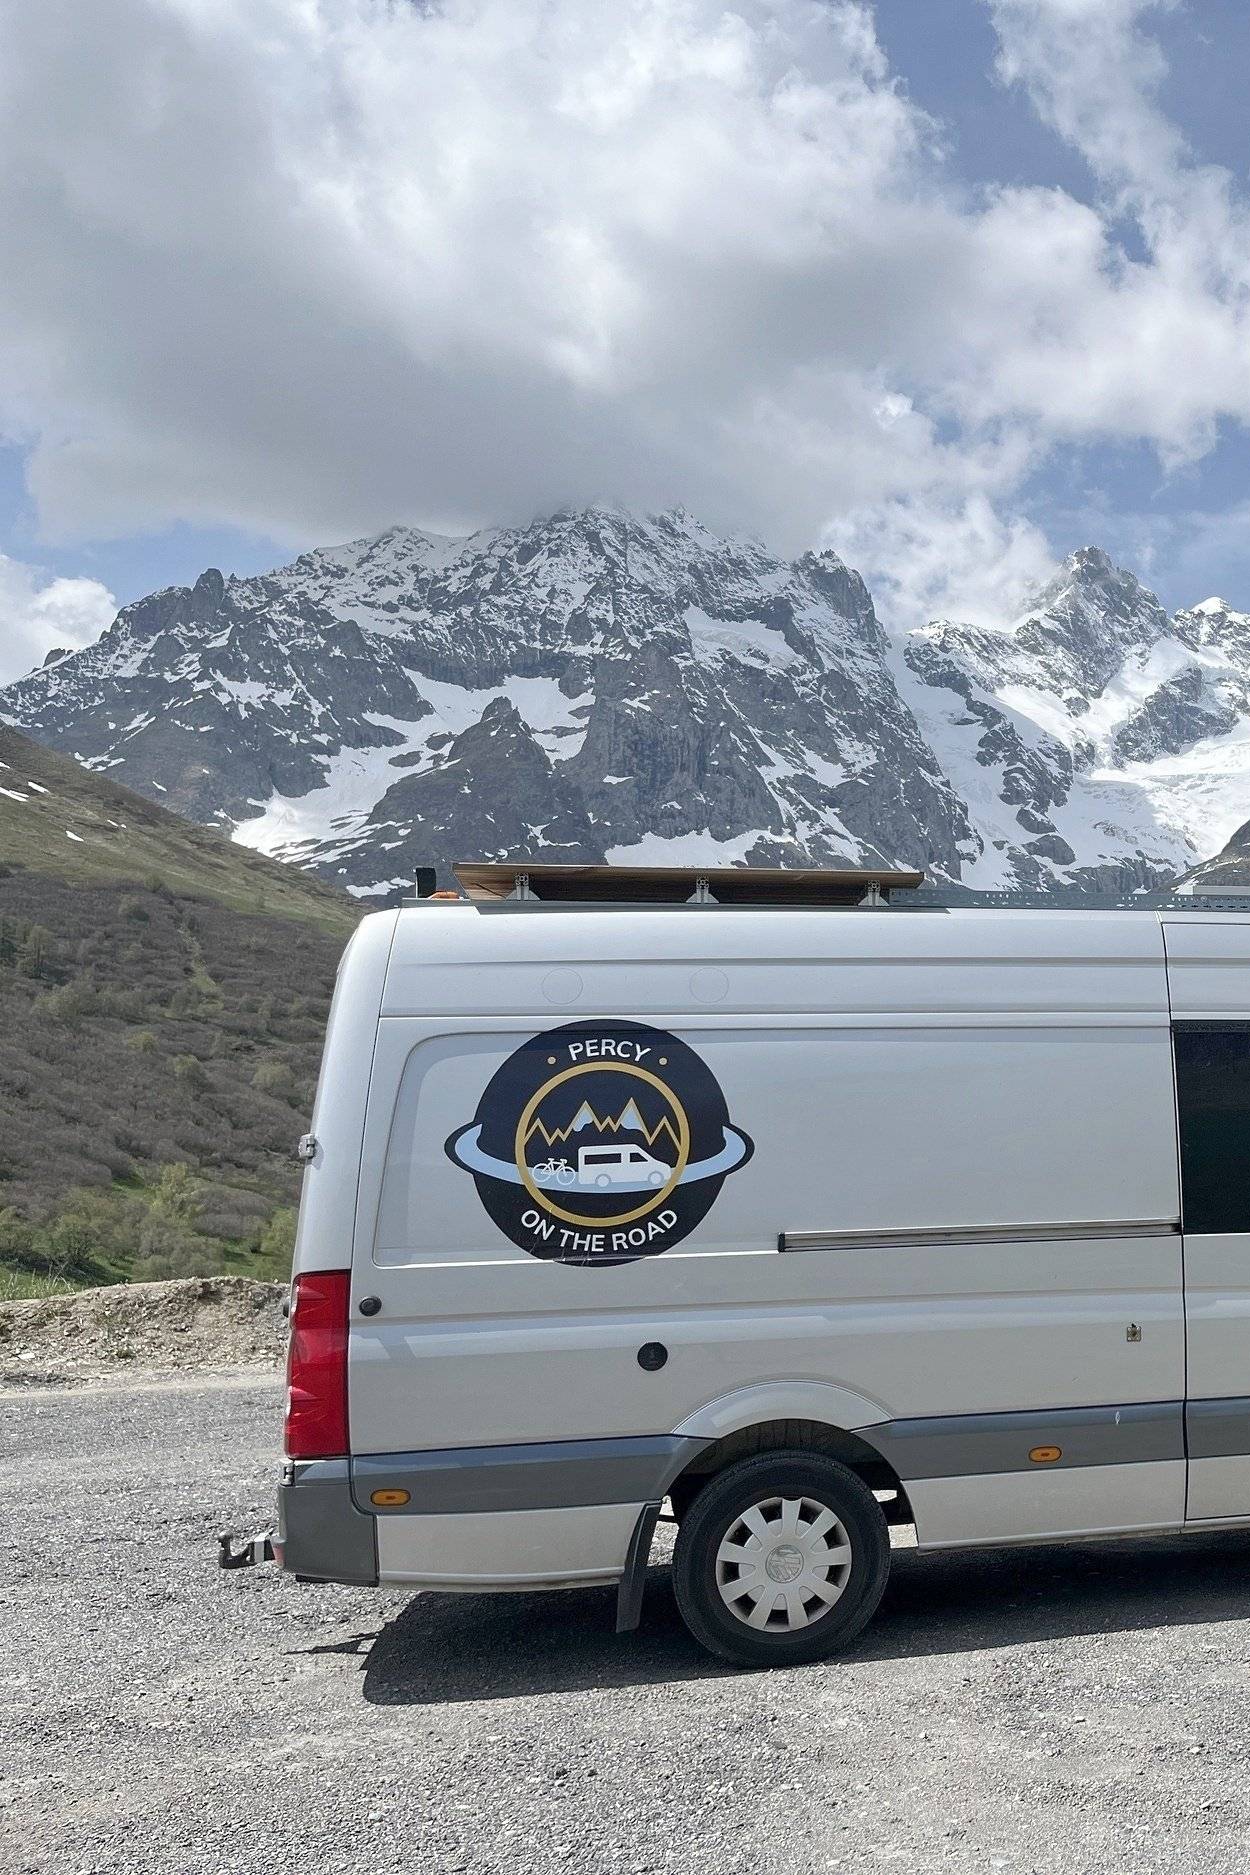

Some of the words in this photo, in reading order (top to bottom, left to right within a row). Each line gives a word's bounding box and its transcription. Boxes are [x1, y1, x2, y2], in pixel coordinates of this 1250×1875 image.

[569, 1038, 651, 1061] PERCY
[521, 1209, 555, 1240] ON
[559, 1229, 605, 1252] THE
[612, 1209, 678, 1251] ROAD
